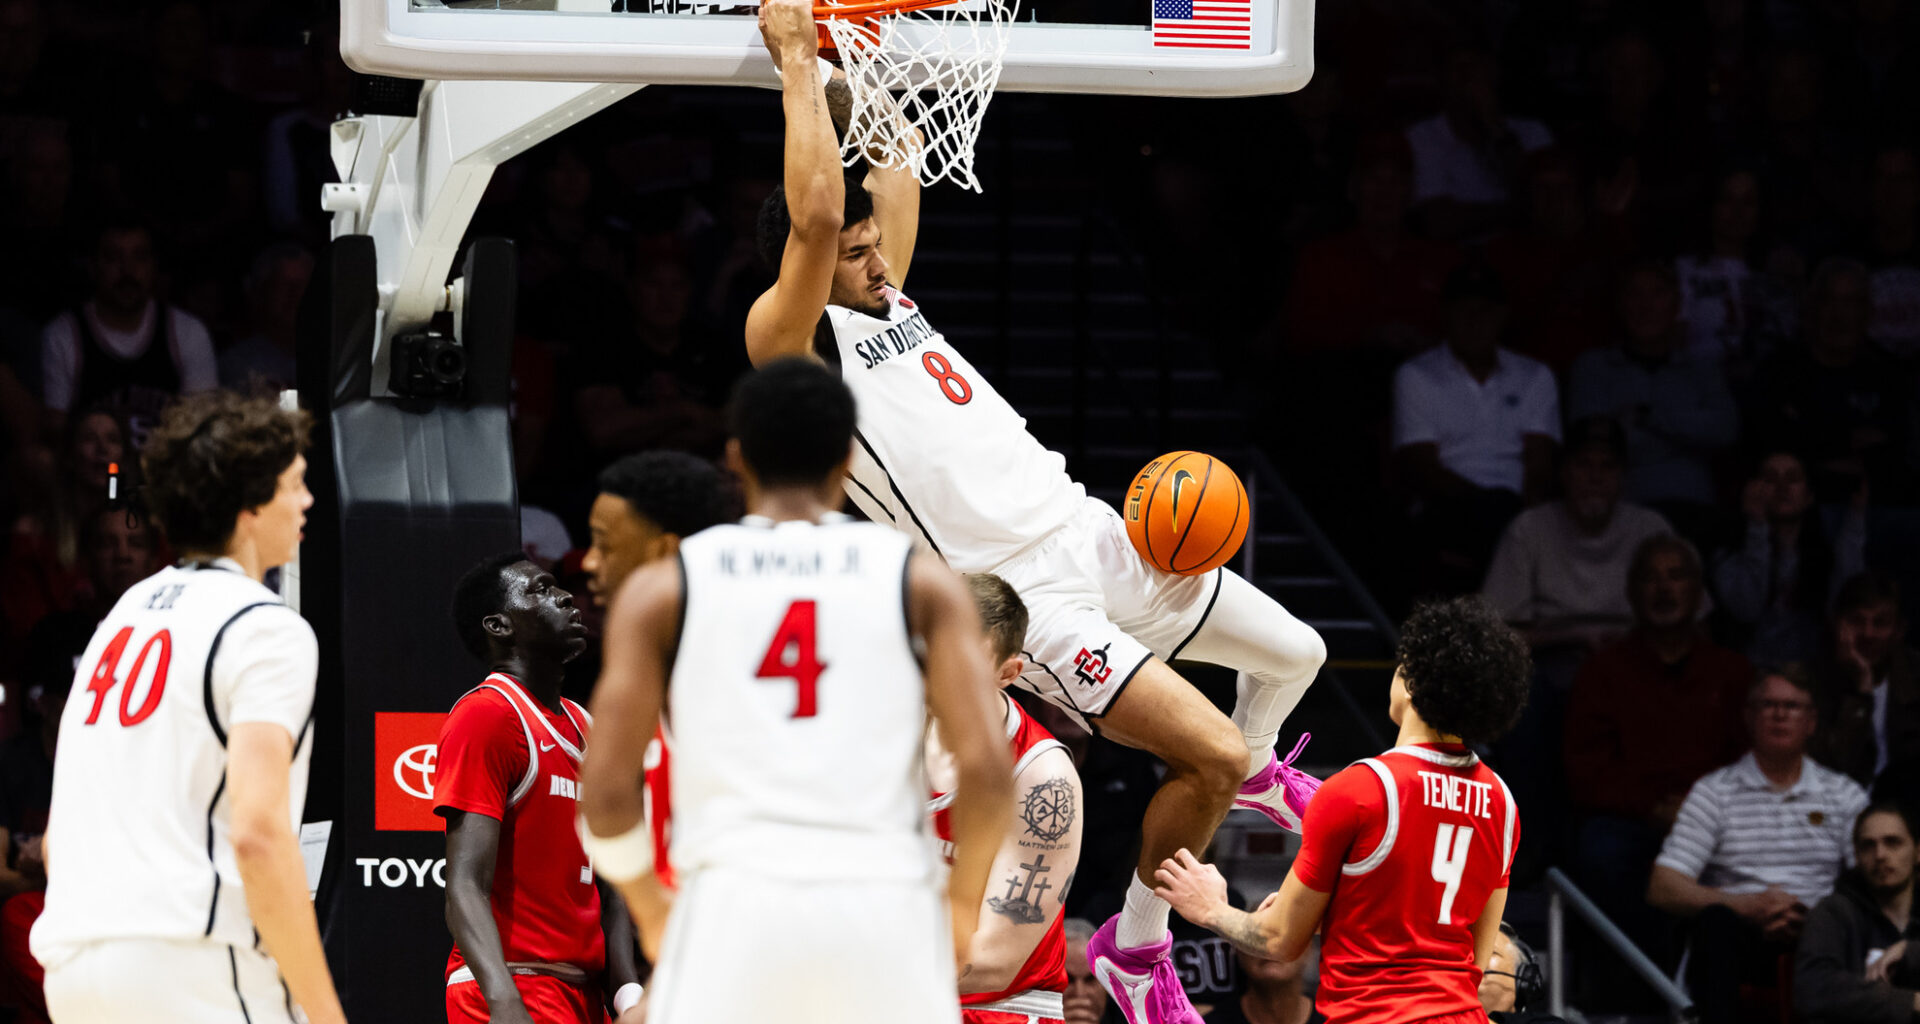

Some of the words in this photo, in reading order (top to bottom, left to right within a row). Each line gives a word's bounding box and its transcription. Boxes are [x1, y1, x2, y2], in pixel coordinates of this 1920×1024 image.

[855, 334, 893, 369] SAN
[922, 351, 972, 405] 8
[1129, 461, 1162, 521] ELITE
[84, 626, 172, 728] 40
[754, 598, 829, 720] 4
[550, 774, 576, 800] NEW
[1417, 770, 1492, 819] TENETTE
[1431, 822, 1474, 925] 4
